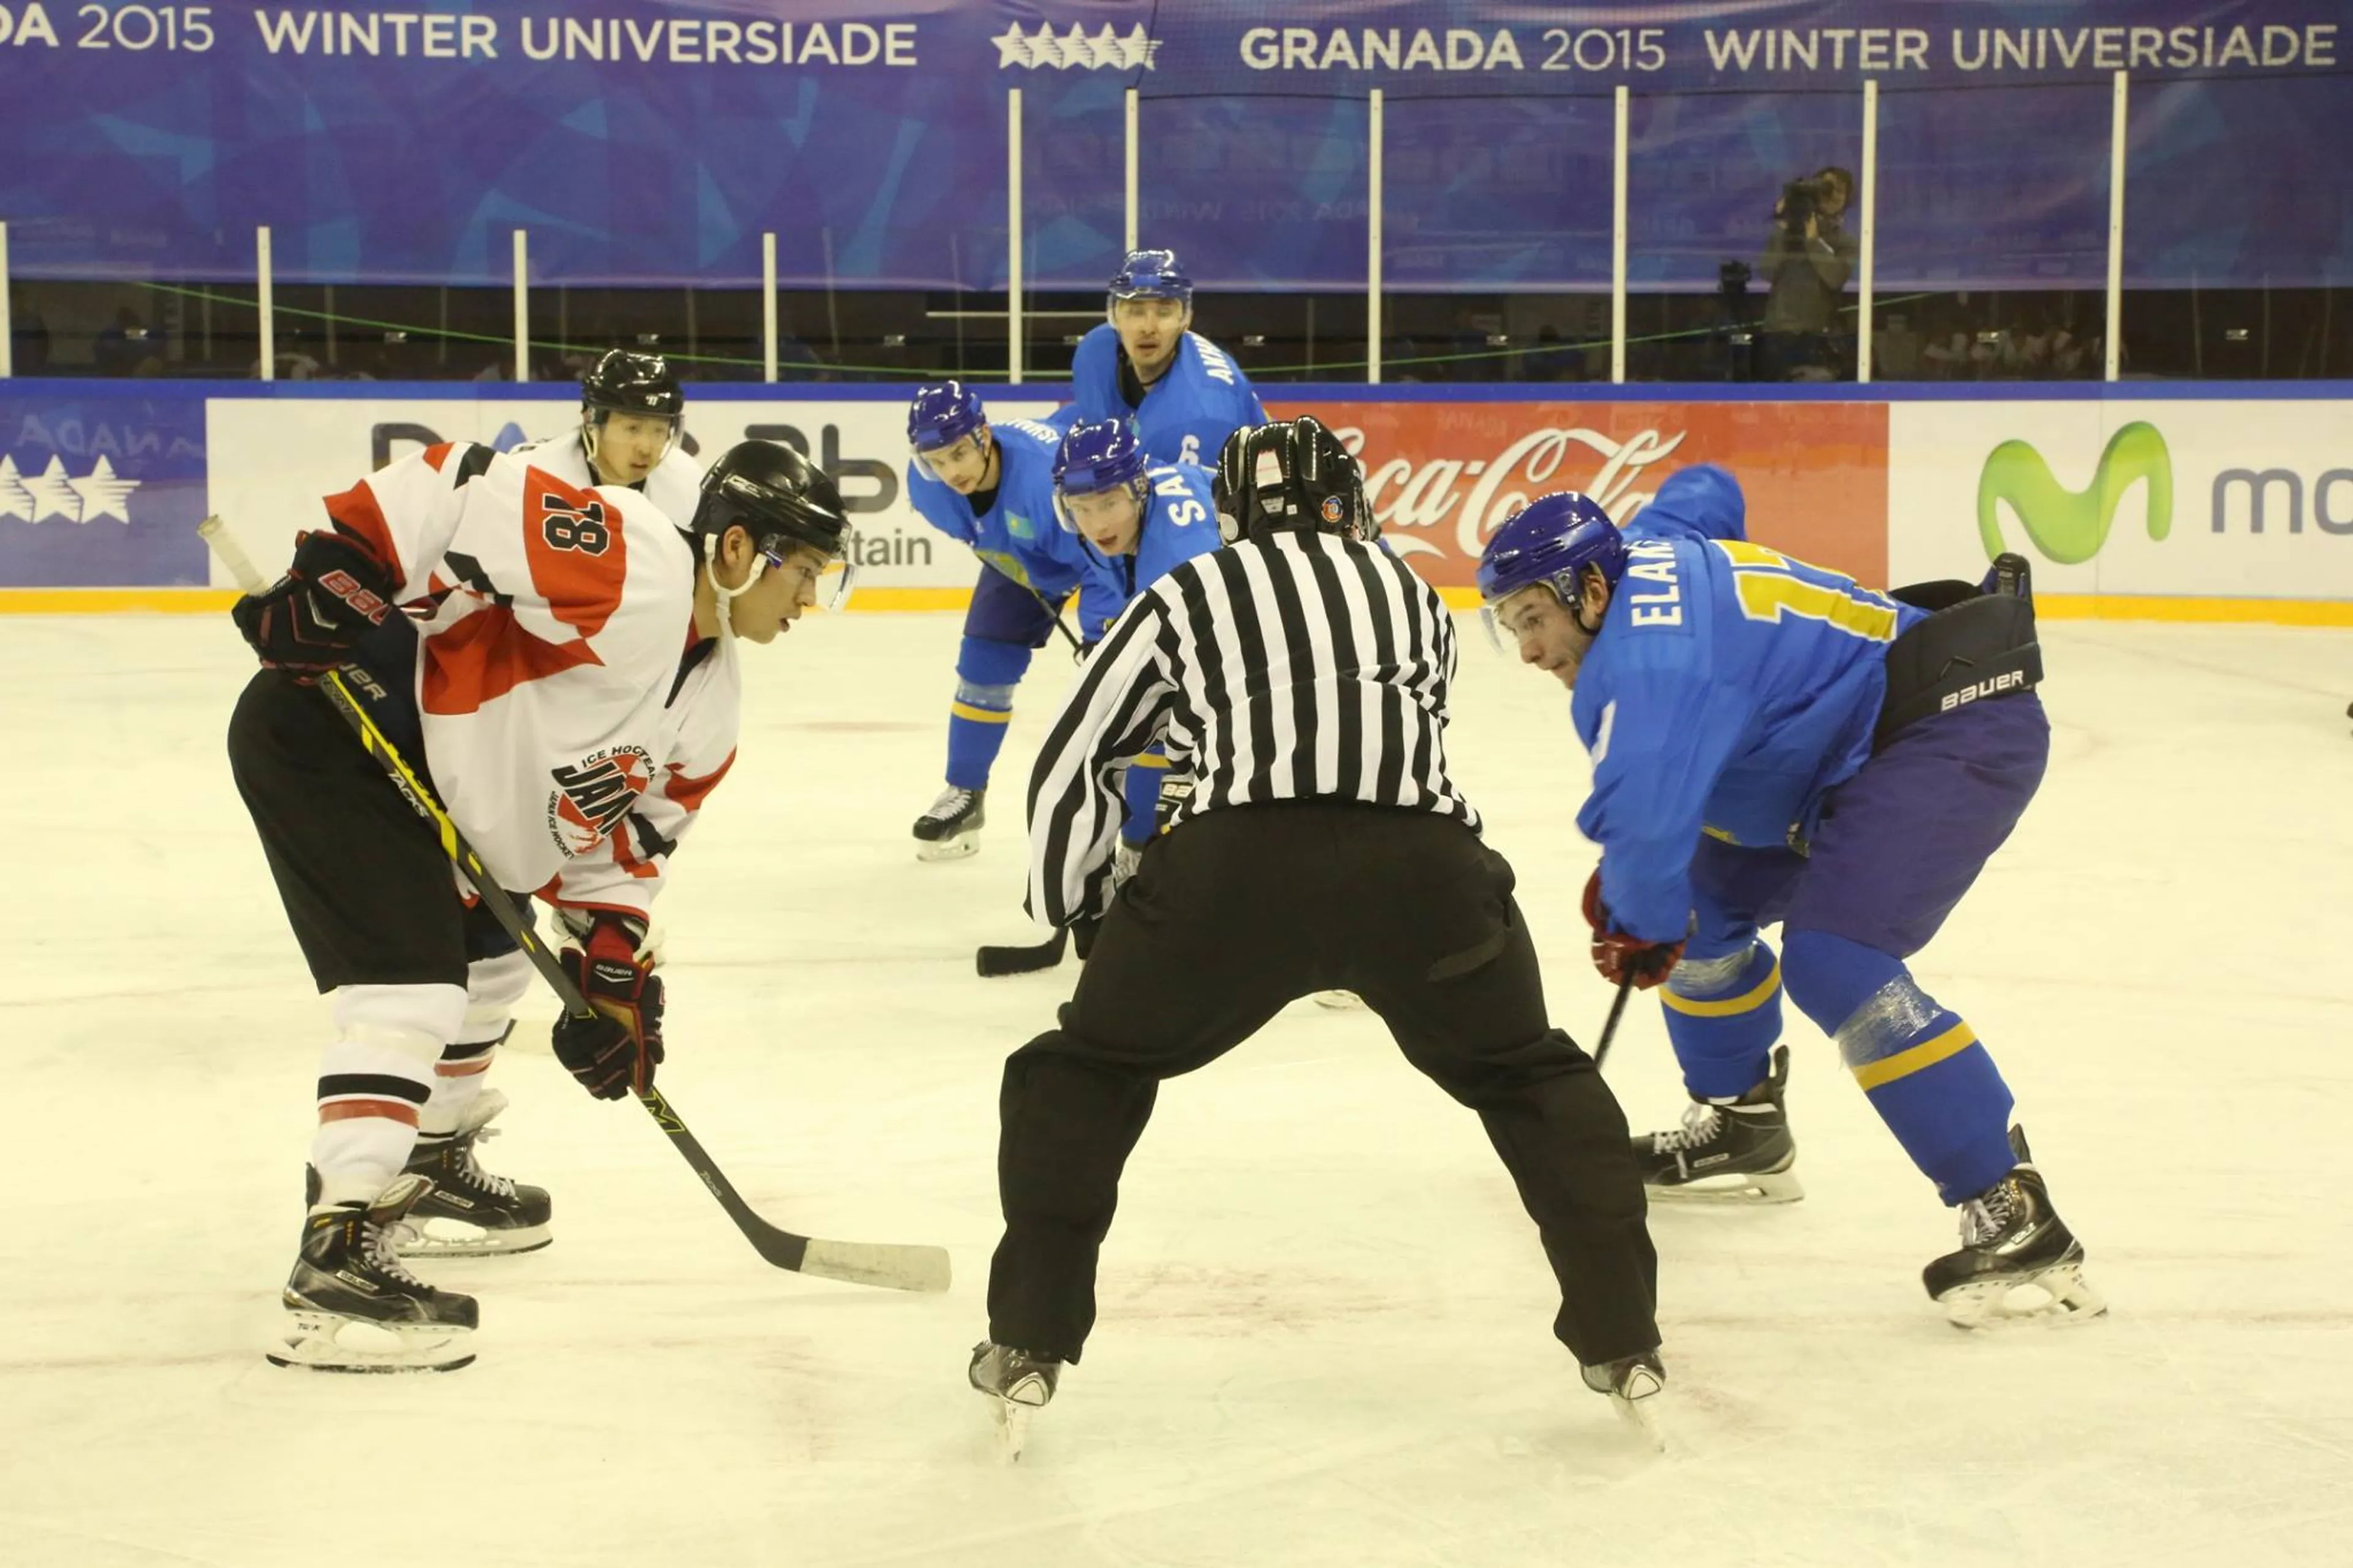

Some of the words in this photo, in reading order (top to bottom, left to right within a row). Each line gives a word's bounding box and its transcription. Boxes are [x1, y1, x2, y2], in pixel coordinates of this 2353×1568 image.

[77, 5, 214, 52] 2015
[254, 10, 498, 58] WINTER
[521, 17, 918, 66] UNIVERSIADE
[1240, 28, 1525, 71] GRANADA
[1540, 28, 1666, 71] 2015
[1703, 28, 1930, 71] WINTER
[1952, 25, 2338, 70] UNIVERSIADE
[542, 493, 610, 558] 18
[2211, 468, 2353, 535] mo
[582, 749, 607, 768] ICE
